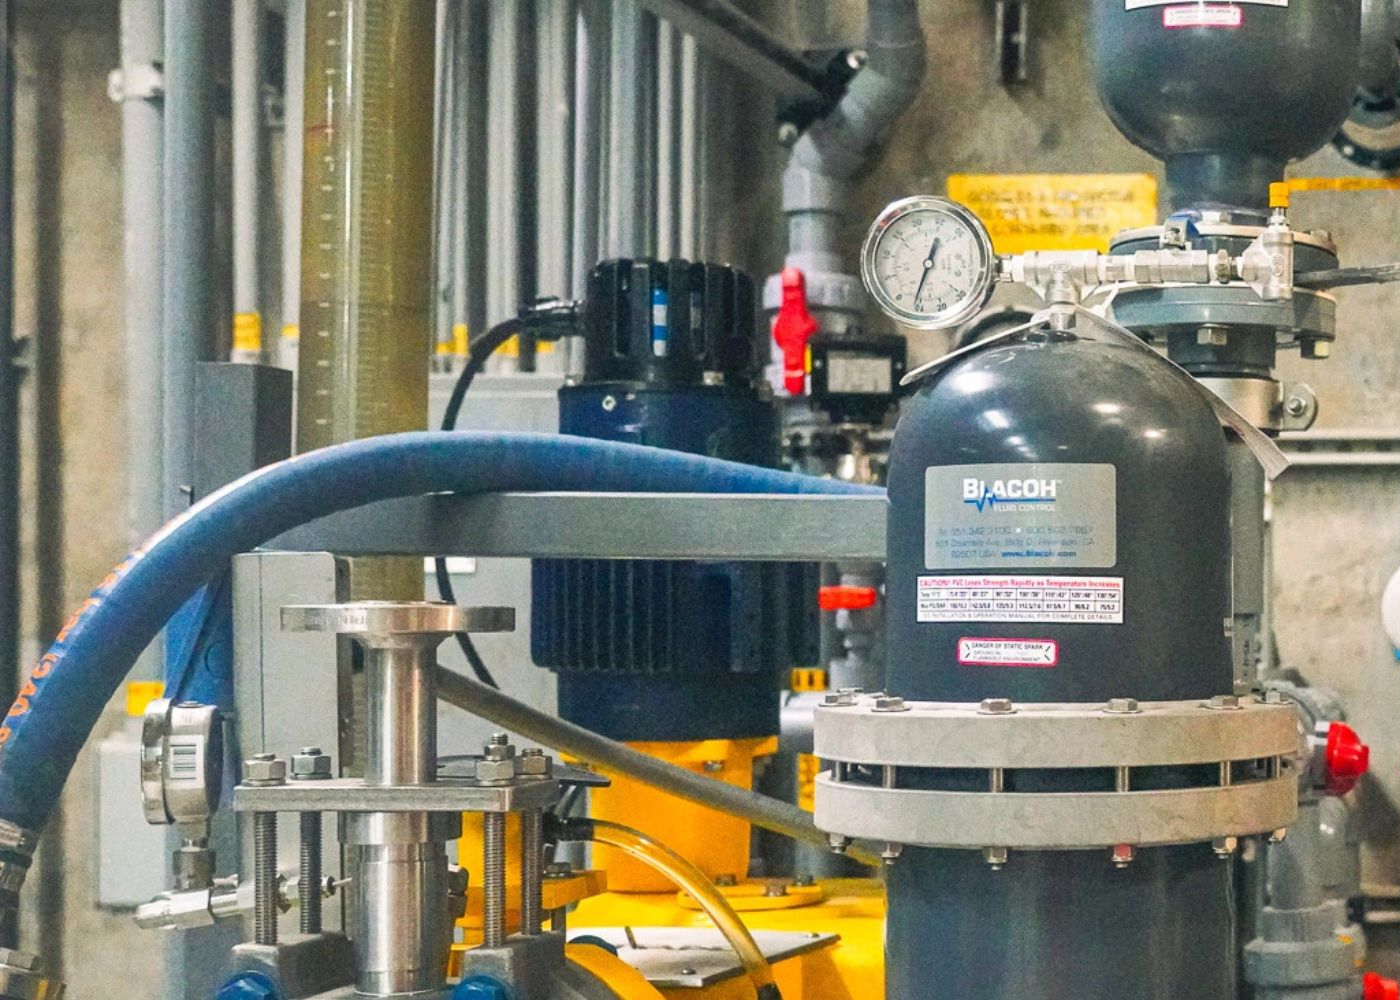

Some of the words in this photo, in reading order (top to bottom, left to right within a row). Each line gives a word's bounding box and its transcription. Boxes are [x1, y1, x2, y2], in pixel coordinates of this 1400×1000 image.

[963, 478, 1056, 498] BLACOH
[993, 504, 1016, 512] FLUID
[1018, 504, 1056, 512] CONTROL
[983, 579, 1008, 587] Strength
[1010, 579, 1035, 587] Rapidly
[1046, 579, 1087, 587] Temperature
[1089, 580, 1120, 588] Increases
